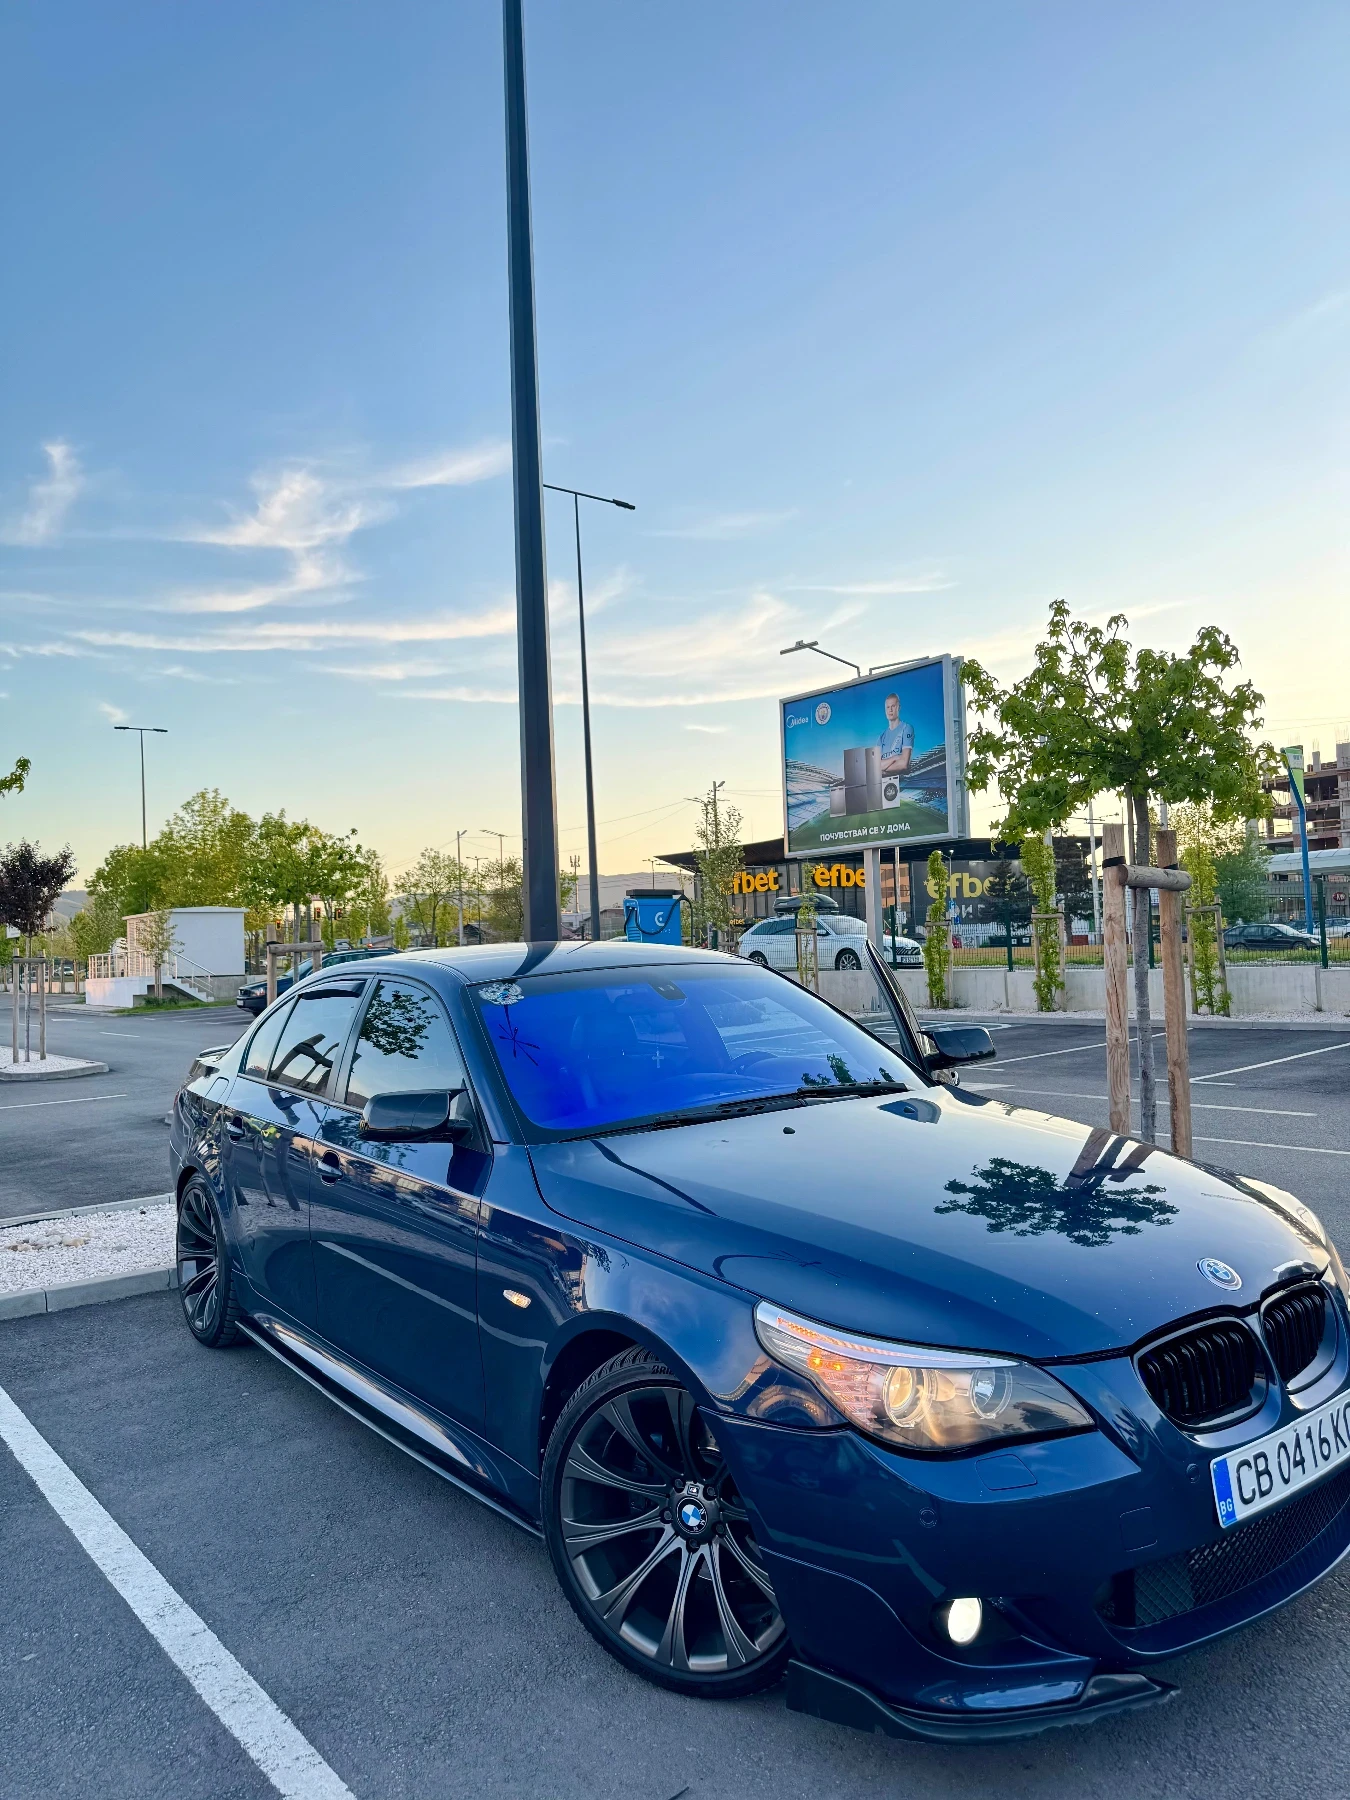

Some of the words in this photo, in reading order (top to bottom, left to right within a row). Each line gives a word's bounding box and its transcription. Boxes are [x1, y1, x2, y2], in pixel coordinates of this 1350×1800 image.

[787, 715, 809, 728] Midea
[820, 827, 868, 841] ПОЧУВСТВАЙ
[868, 826, 879, 835] СЕ
[880, 825, 886, 834] У
[886, 822, 911, 834] ДОМА
[721, 867, 779, 895] fbet
[814, 863, 865, 887] efbe
[1236, 1451, 1273, 1505] CB
[1277, 1417, 1331, 1485] 0416
[1220, 1498, 1233, 1515] BG
